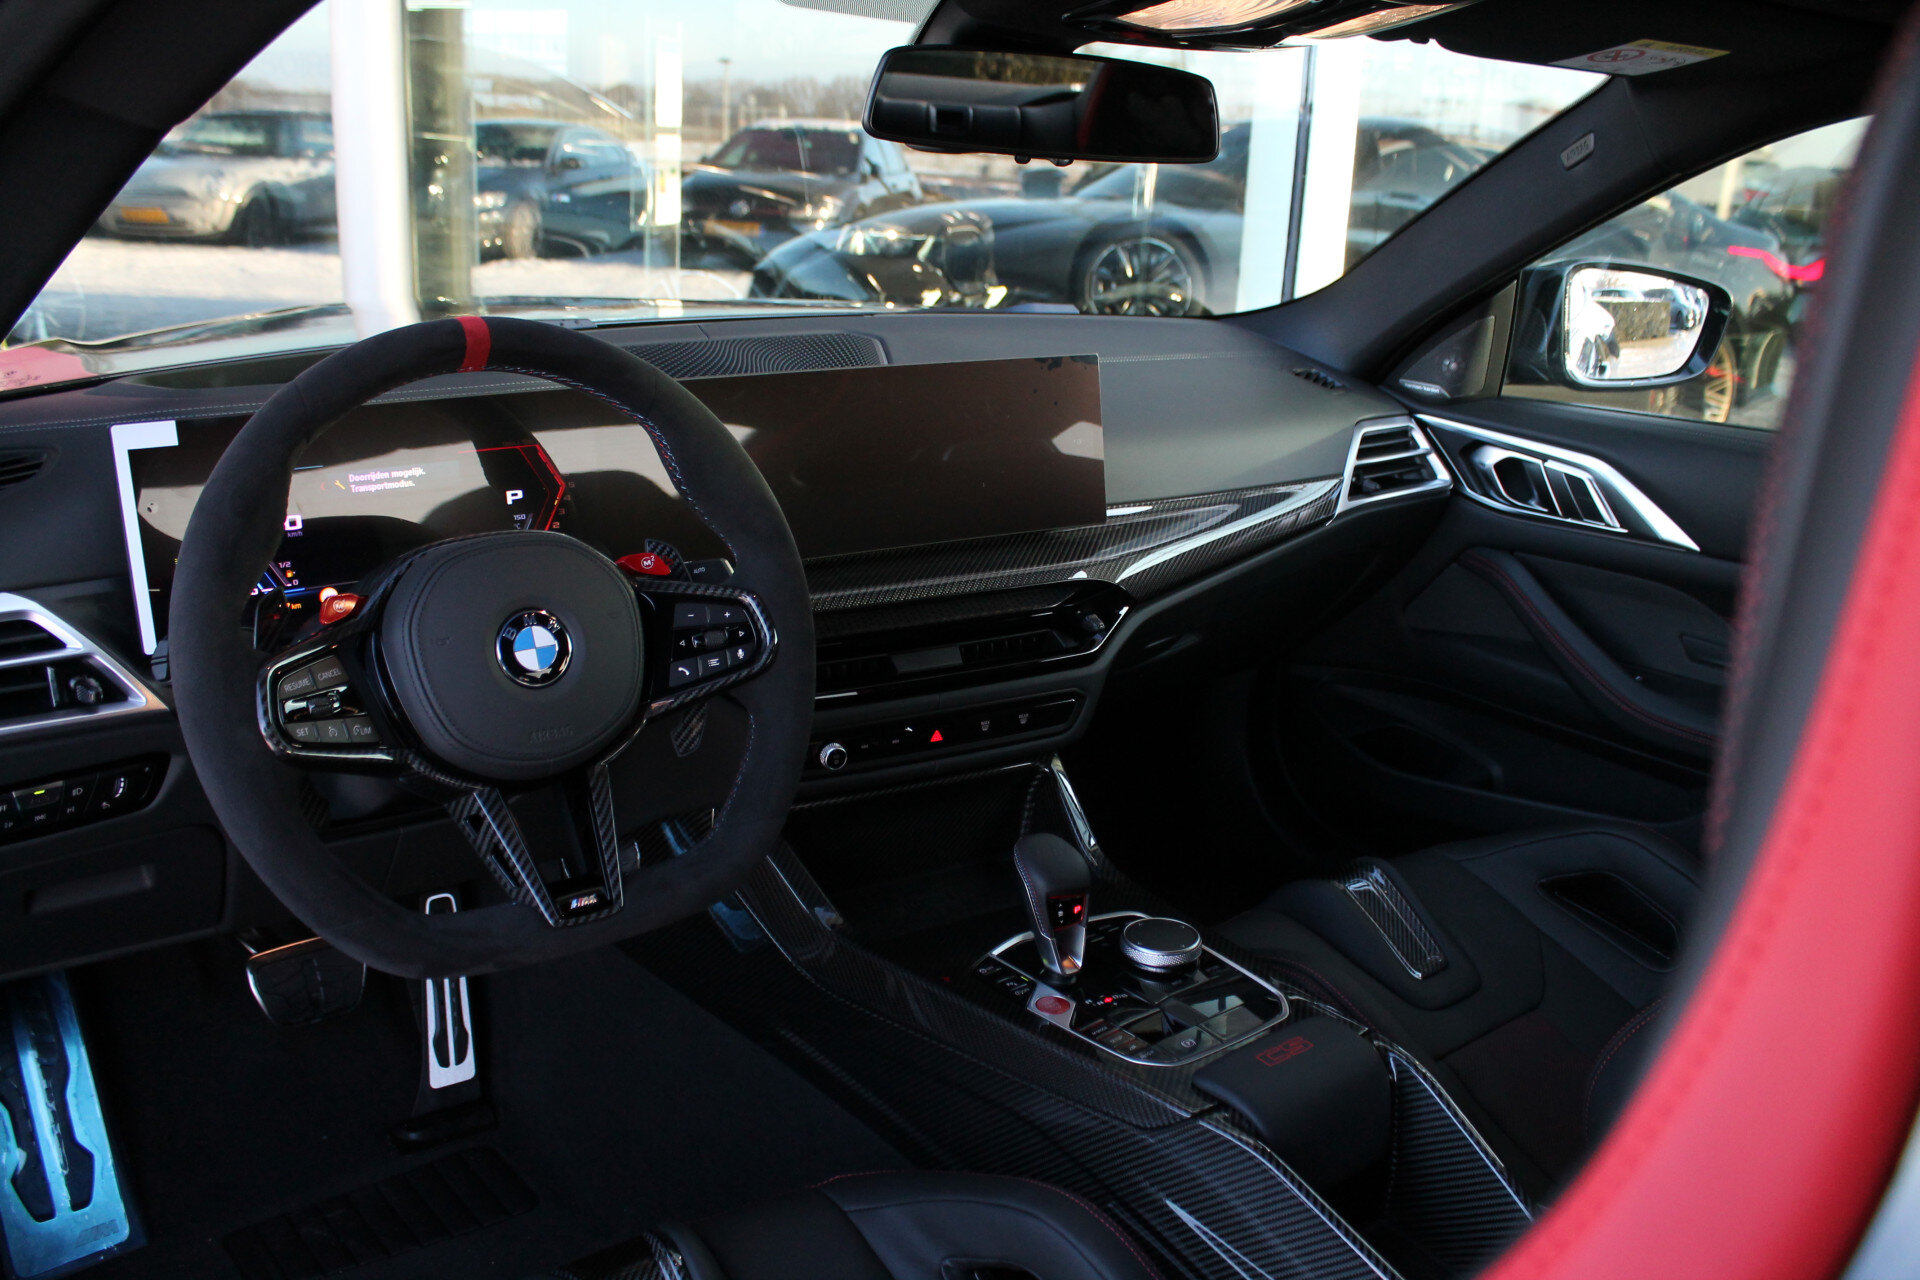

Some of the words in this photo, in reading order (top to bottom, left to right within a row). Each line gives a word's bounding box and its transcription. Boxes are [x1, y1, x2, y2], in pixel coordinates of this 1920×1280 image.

[349, 471, 390, 483] Doorrijden
[391, 466, 427, 479] mogelijk.
[350, 479, 416, 493] Transportmodus.
[506, 489, 524, 505] P
[502, 612, 561, 641] BMW
[317, 668, 342, 681] CANCEL
[284, 676, 311, 693] RESUME
[296, 727, 309, 738] SET
